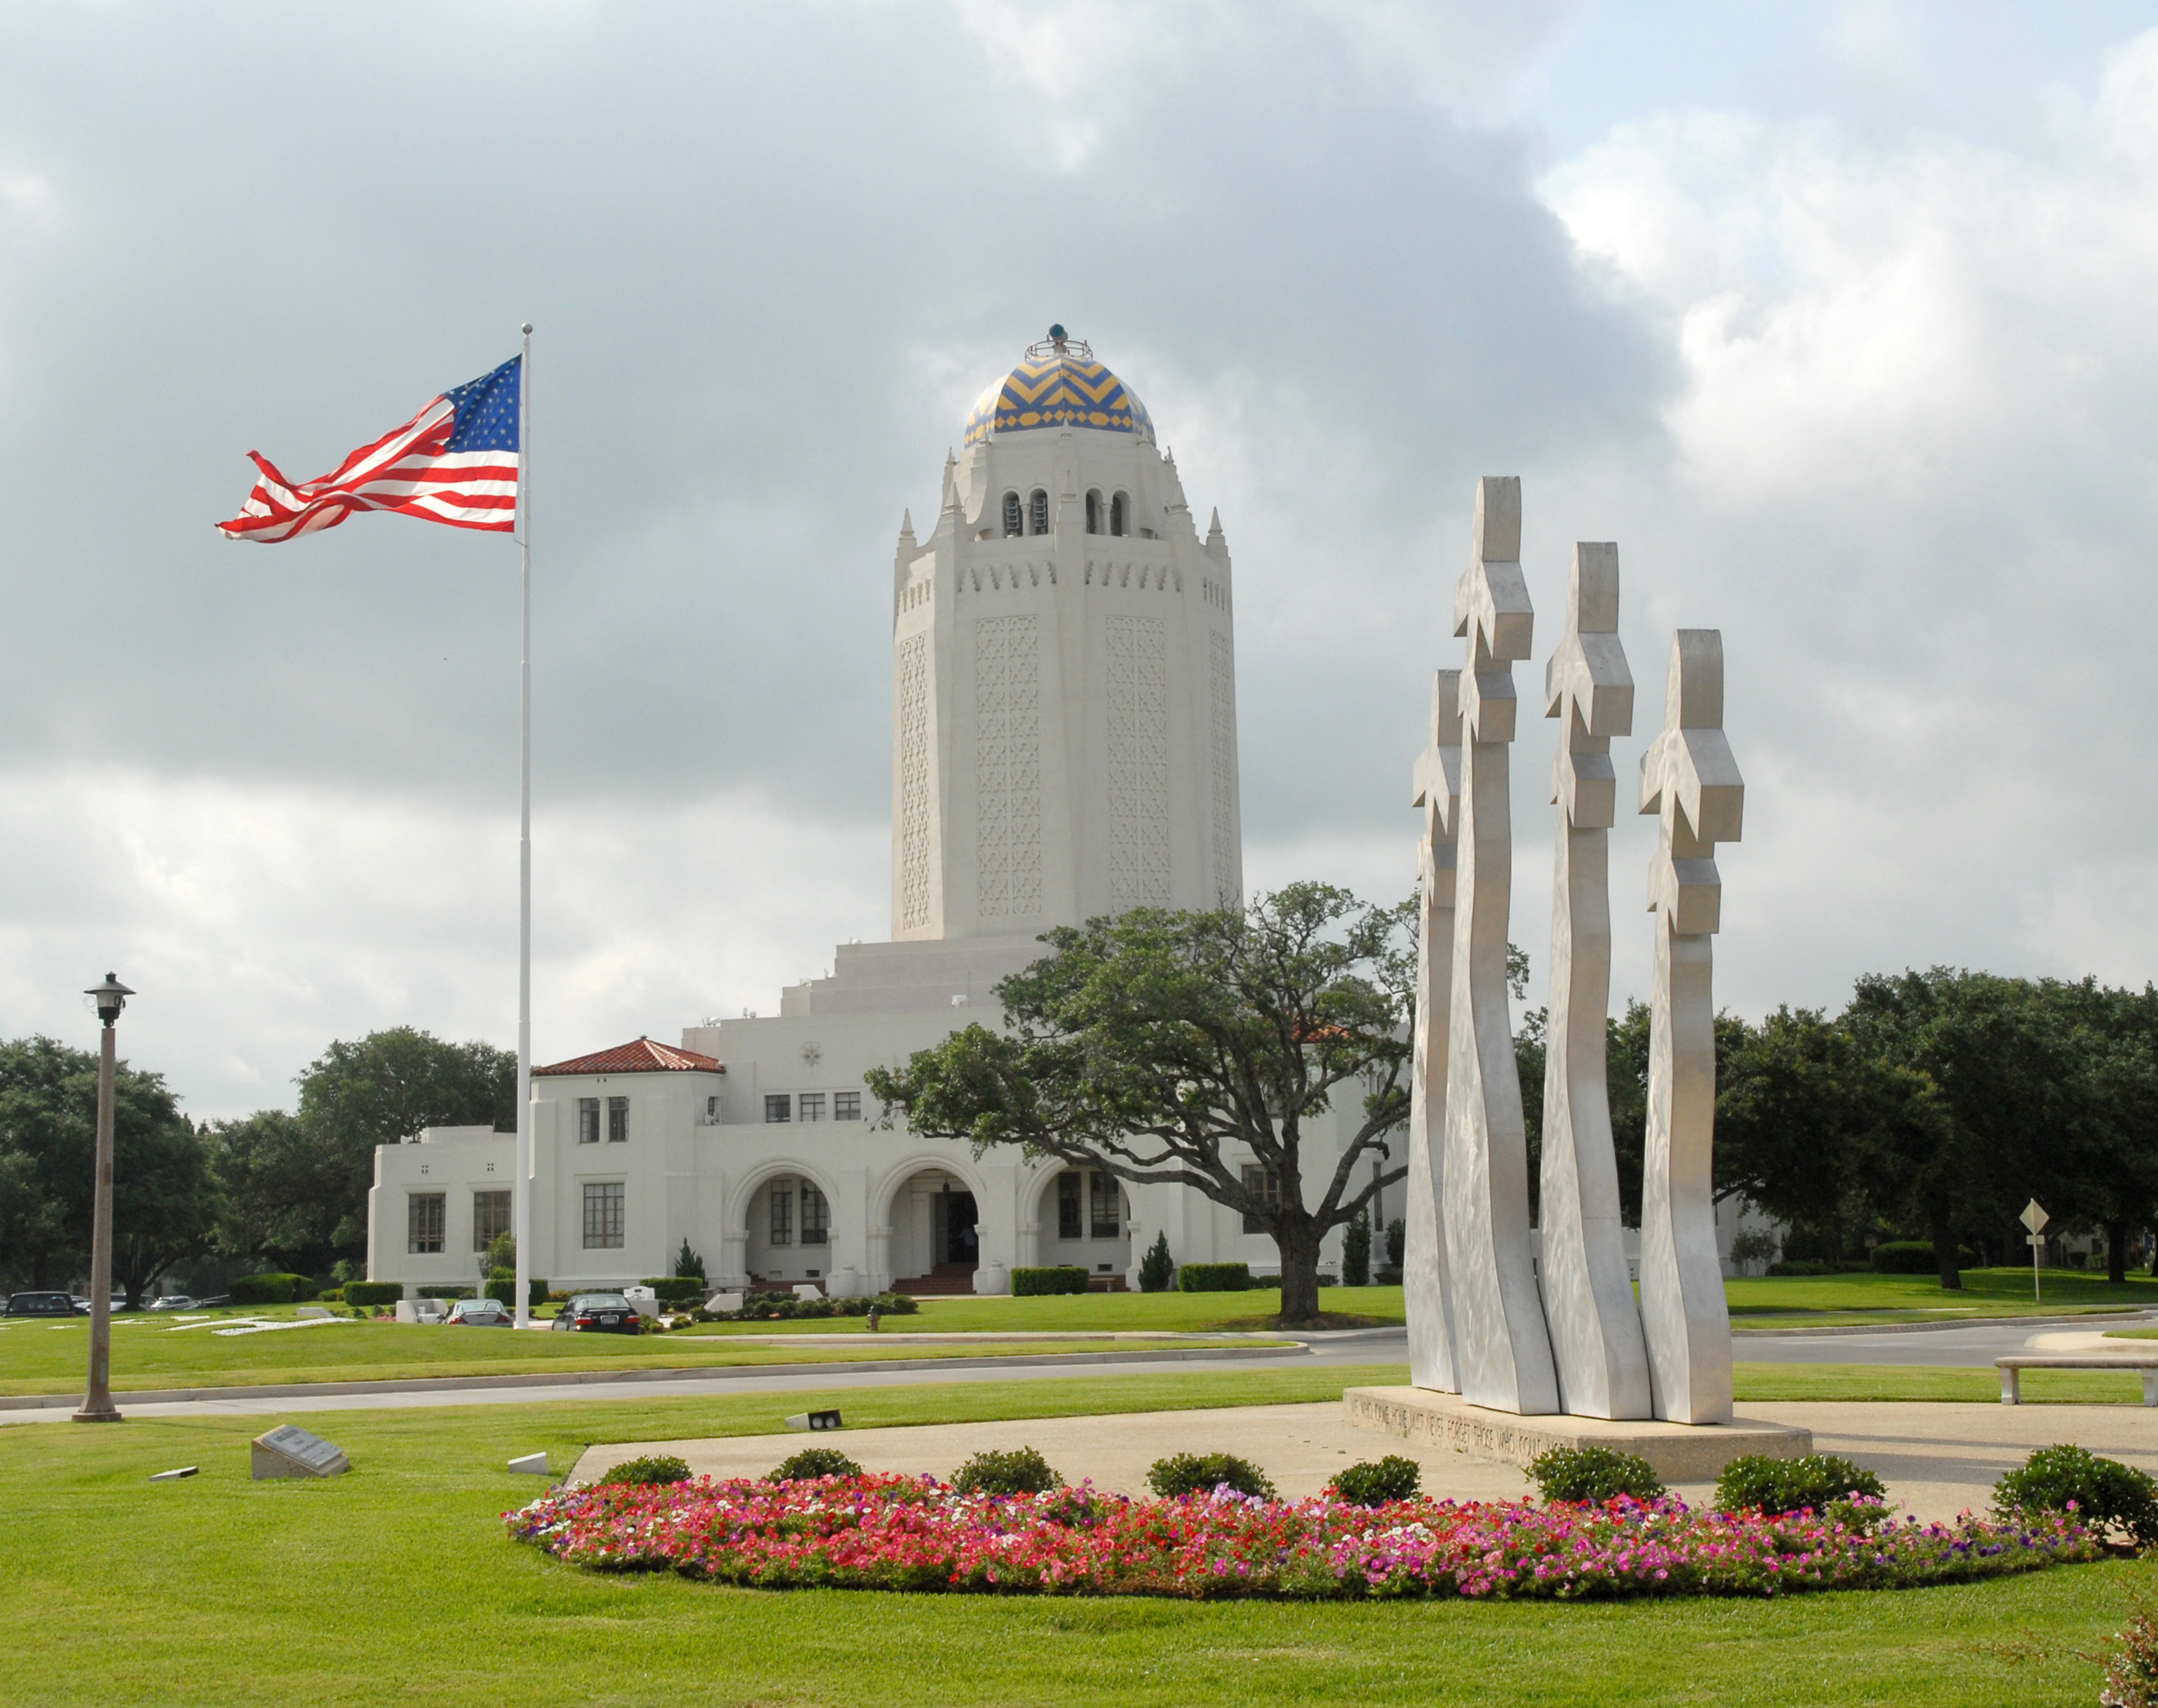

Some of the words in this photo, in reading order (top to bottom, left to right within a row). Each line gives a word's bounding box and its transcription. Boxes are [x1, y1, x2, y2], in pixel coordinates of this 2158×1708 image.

[1392, 1407, 1407, 1429] HOME
[1409, 1412, 1424, 1434] MUST
[1425, 1415, 1443, 1438] NEVER
[1447, 1420, 1470, 1444] FORGET
[1474, 1425, 1493, 1450] THOSE
[1497, 1430, 1515, 1454] WHO
